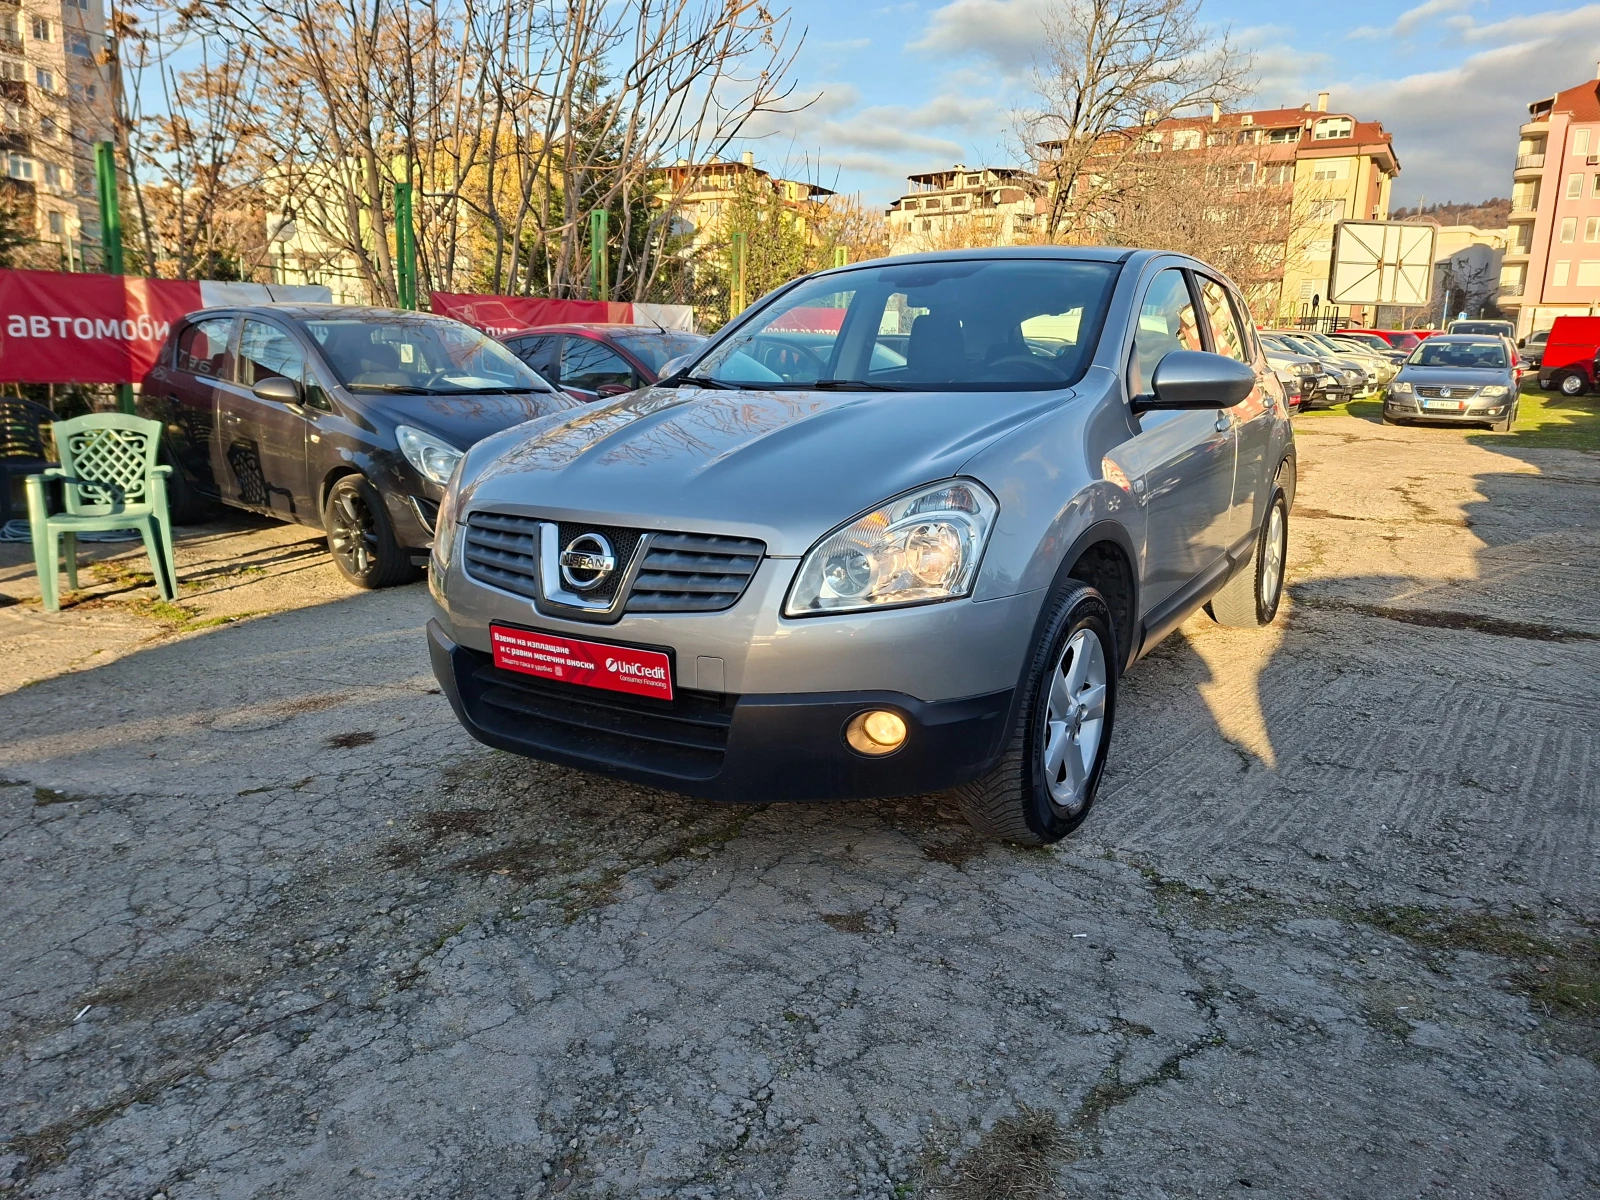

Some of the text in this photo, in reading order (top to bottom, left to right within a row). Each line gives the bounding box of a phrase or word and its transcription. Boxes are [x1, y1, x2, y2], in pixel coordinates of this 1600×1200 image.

[7, 313, 170, 342] автомоби
[563, 553, 605, 568] NISSAN
[494, 632, 570, 655] Вземи на изплащане
[511, 647, 533, 658] равни
[533, 651, 565, 665] месечни
[566, 658, 595, 670] вноски
[618, 660, 666, 680] UniCredit
[619, 675, 667, 690] Consumer Financing
